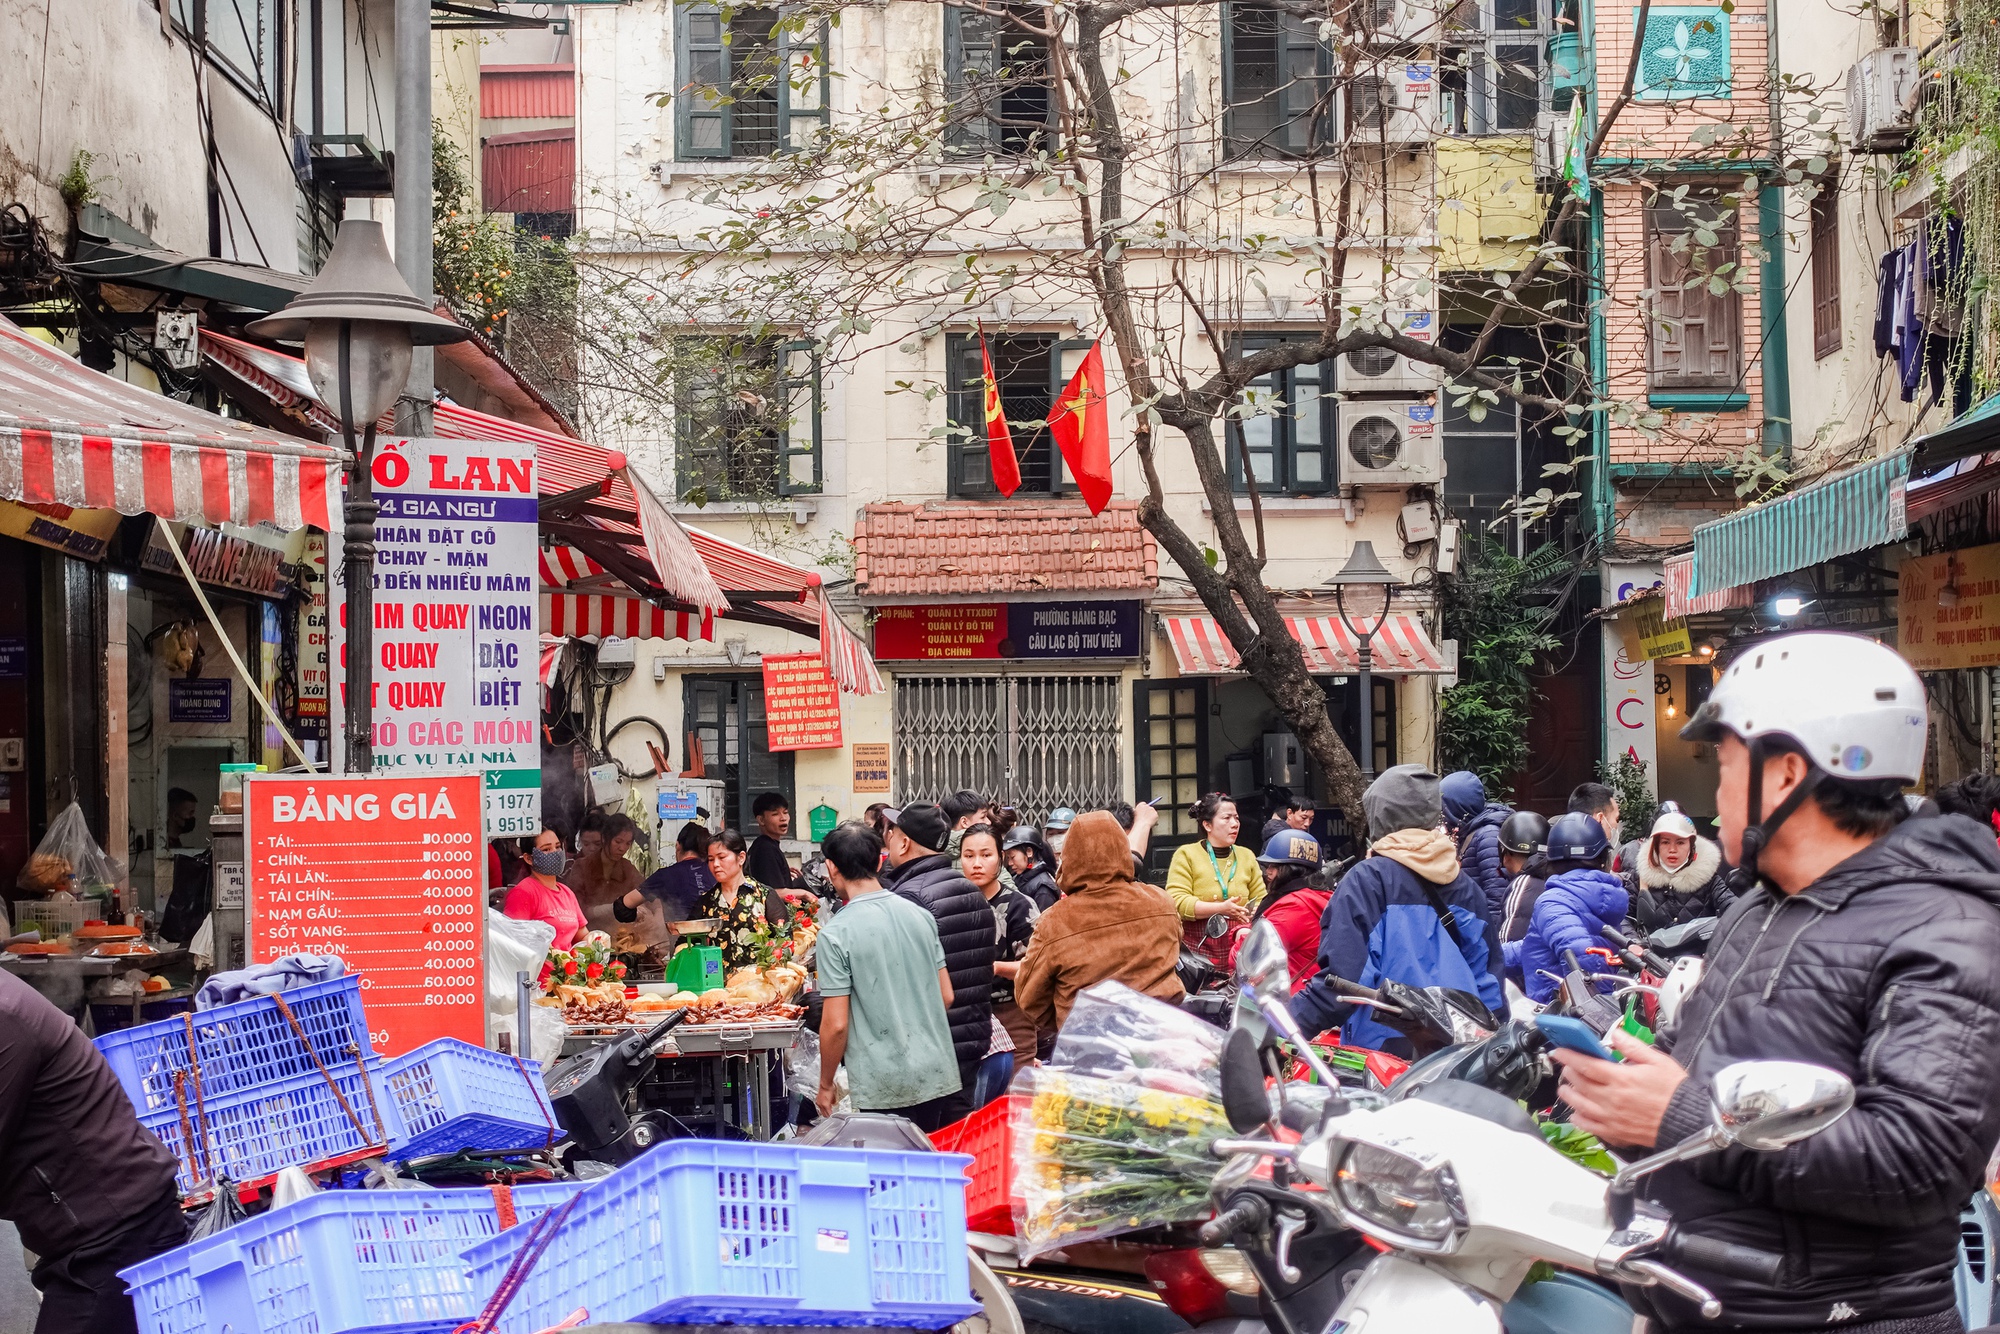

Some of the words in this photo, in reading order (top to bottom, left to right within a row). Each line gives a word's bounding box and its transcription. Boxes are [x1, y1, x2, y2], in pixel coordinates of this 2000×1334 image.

[429, 455, 533, 493] LAN
[402, 500, 442, 516] GIA
[446, 501, 496, 518] NGƯ
[428, 527, 464, 546] ĐẶT
[378, 550, 427, 566] CHAY
[447, 550, 488, 570] MẶN
[384, 570, 421, 590] ĐẾN
[426, 570, 481, 591] NHIỀU
[486, 573, 530, 592] MÂM
[412, 603, 470, 632] QUAY
[478, 605, 532, 630] NGON
[928, 606, 952, 618] QUẢN
[954, 607, 964, 617] LÝ
[1034, 609, 1070, 626] PHƯỜNG
[1072, 608, 1096, 625] HÀNG
[1098, 610, 1116, 628] BẠC
[1975, 602, 1983, 620] LÝ
[928, 620, 952, 630] QUẢN
[954, 620, 964, 630] LÝ
[966, 620, 979, 630] ĐÔ
[980, 621, 994, 632] THỊ
[928, 633, 952, 644] QUẢN
[954, 633, 964, 643] LÝ
[966, 632, 984, 643] NHÀ
[1028, 632, 1047, 650] CÂU
[1049, 633, 1066, 652] LẠC
[1068, 632, 1080, 652] BỘ
[1082, 633, 1100, 648] THƯ
[1102, 630, 1121, 651] VIỆN
[1936, 630, 1955, 648] PHỤC
[1966, 624, 1986, 646] NHIỆT
[381, 642, 440, 672] QUAY
[479, 639, 519, 674] ĐẶC
[928, 648, 943, 658] ĐỊA
[944, 646, 972, 656] CHÍNH
[303, 670, 318, 684] VỊT
[304, 684, 324, 696] XÔI
[388, 682, 446, 711] QUAY
[479, 677, 522, 711] BIỆT
[180, 698, 202, 708] HOÀNG
[202, 698, 221, 708] DUNG
[300, 702, 316, 712] NGON
[408, 718, 464, 746] CÁC
[474, 716, 533, 745] MÓN
[414, 753, 438, 769] VỤ
[445, 752, 474, 768] TẠI
[481, 748, 516, 764] NHÀ
[273, 786, 380, 822] BẢNG
[390, 786, 456, 820] GIÁ
[498, 794, 534, 810] 1977
[500, 816, 534, 832] 9515
[268, 834, 294, 848] TÁI:
[268, 852, 308, 866] CHÍN:
[268, 870, 291, 885] TÁI
[296, 870, 329, 884] LĂN:
[268, 888, 292, 902] TÁI
[295, 888, 334, 902] CHÍN:
[422, 886, 474, 898] 40.000
[268, 908, 302, 924] NẠM
[422, 904, 474, 916] 40.000
[302, 926, 346, 938] VANG:
[424, 940, 474, 952] 40.000
[424, 957, 475, 970] 40.000
[1004, 1275, 1123, 1300] VISION
